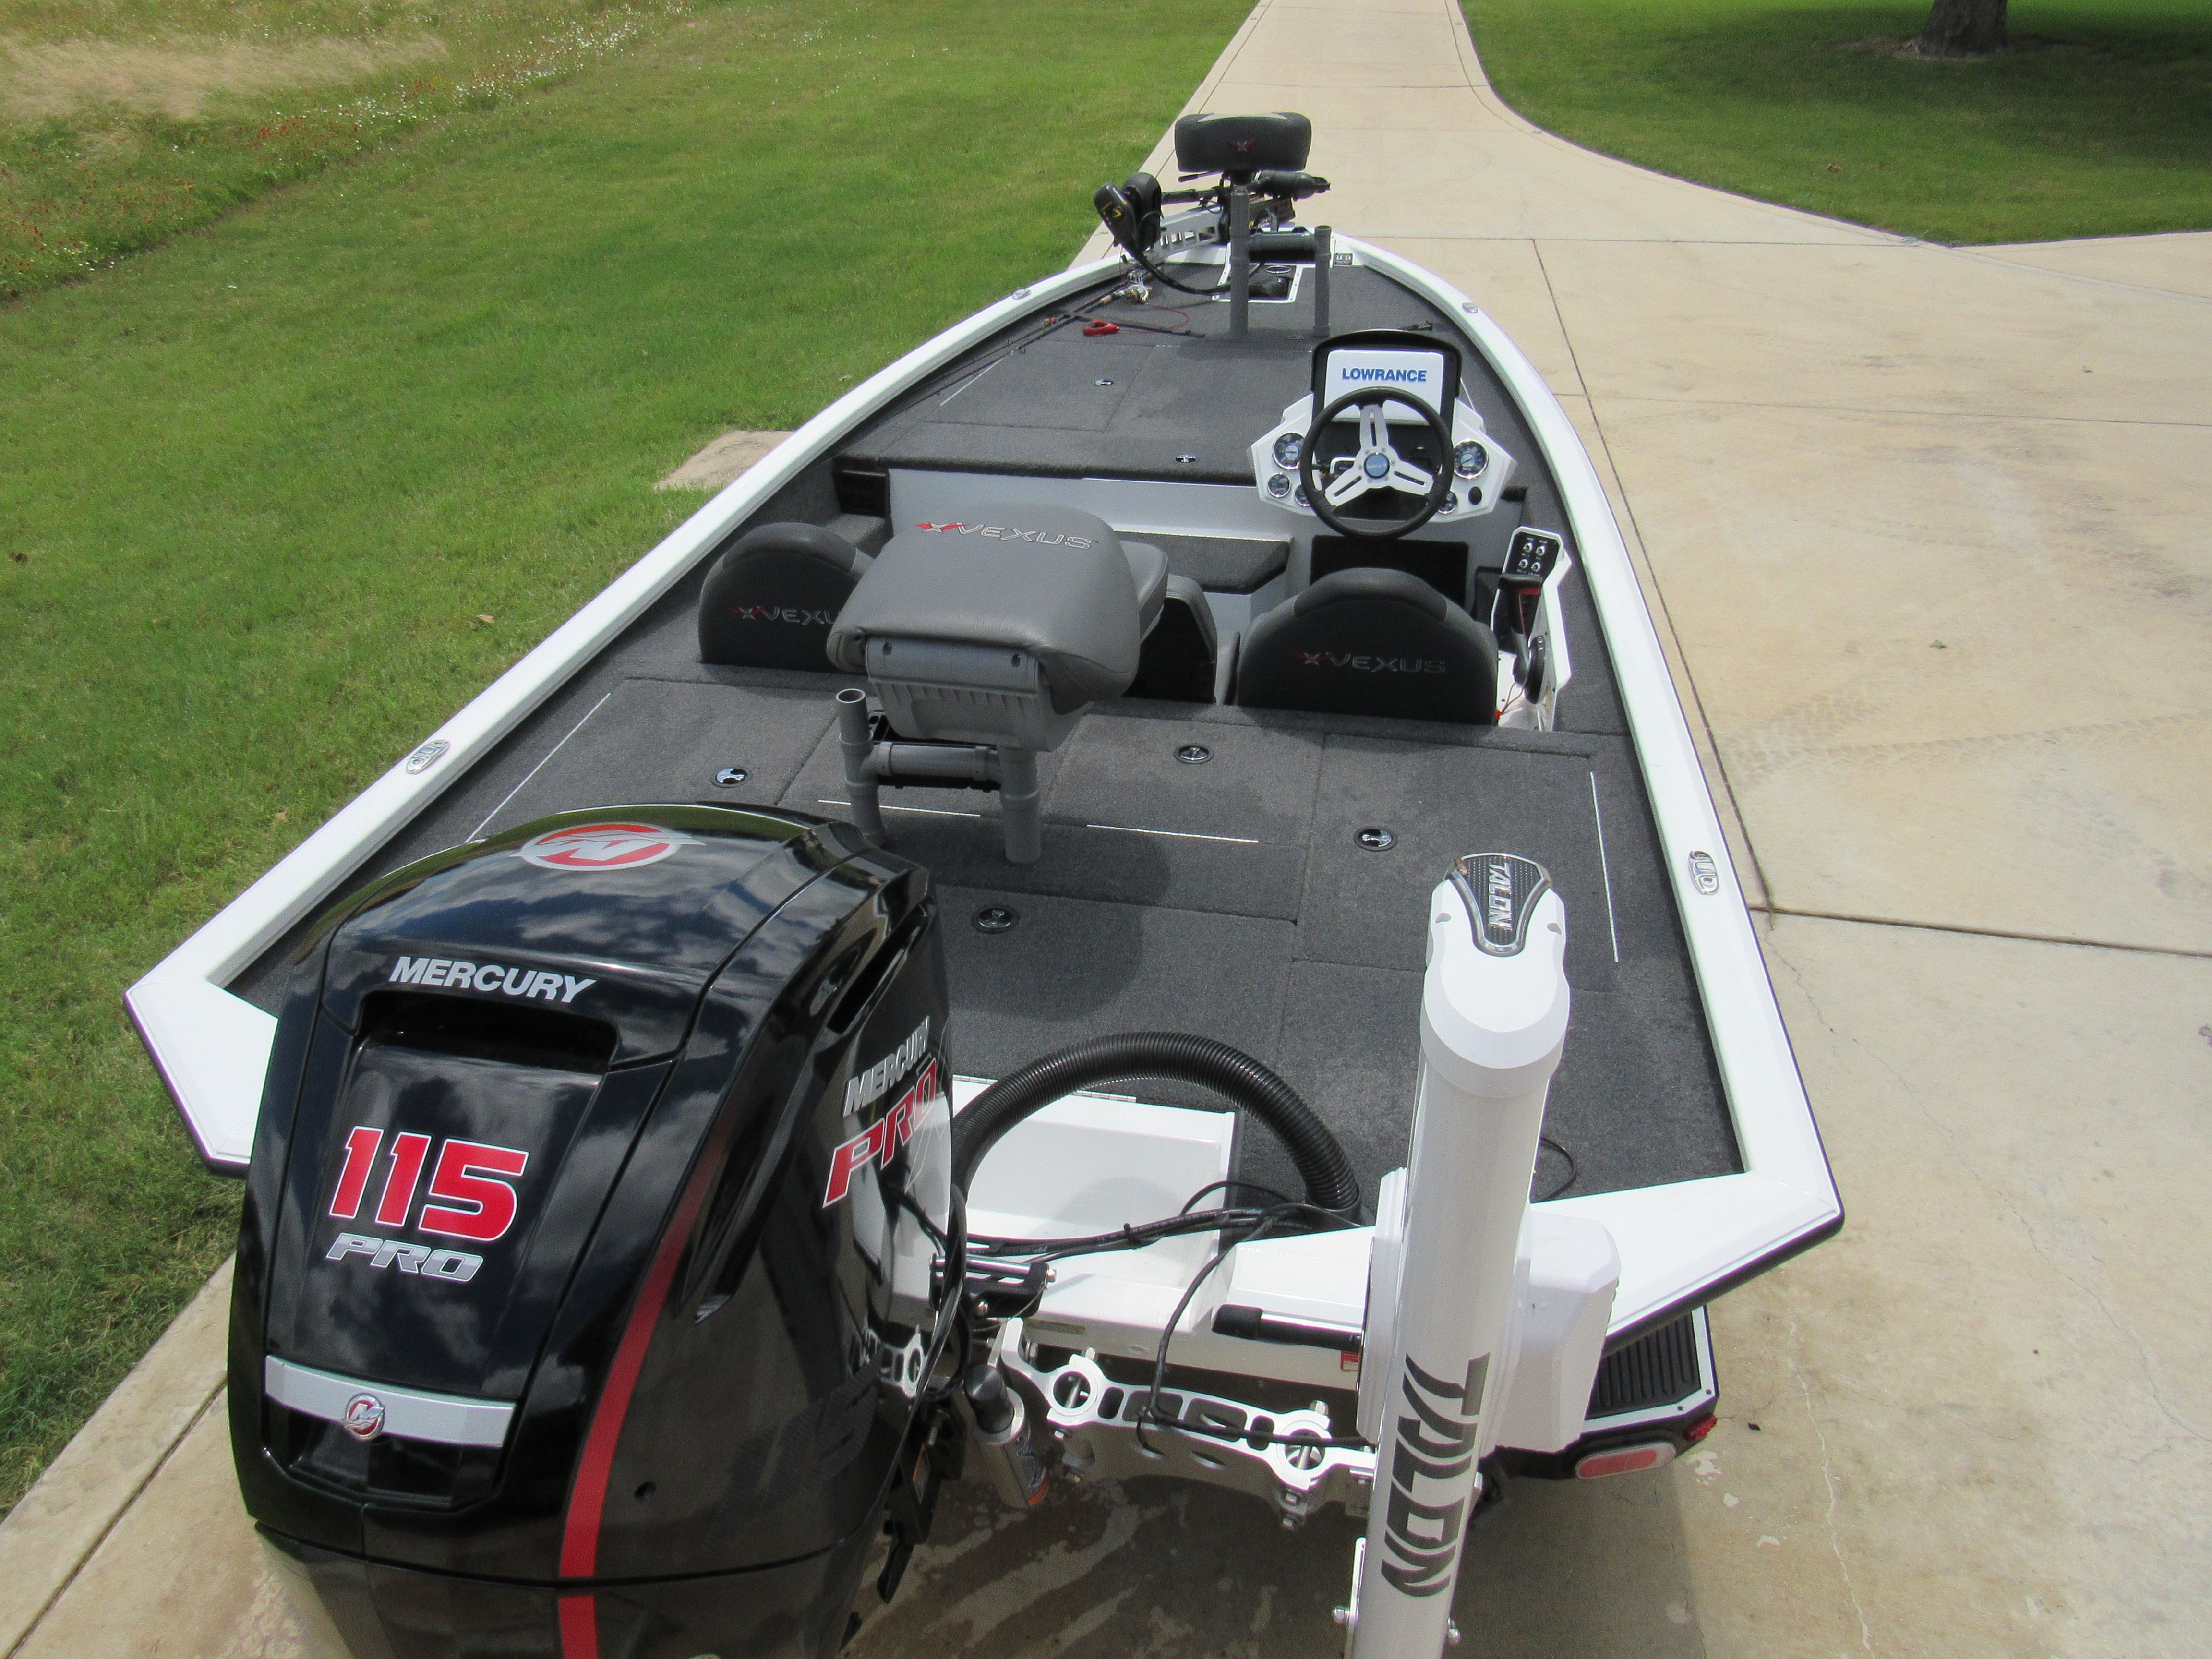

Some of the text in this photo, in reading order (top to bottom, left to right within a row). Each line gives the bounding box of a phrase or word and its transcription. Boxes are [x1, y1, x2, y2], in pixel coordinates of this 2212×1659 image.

[1342, 368, 1427, 382] LOWRANCE
[955, 523, 1092, 550] VEXUS
[761, 606, 835, 625] VEXU
[1326, 652, 1446, 673] VEXUS
[1488, 863, 1513, 930] TALON
[389, 957, 597, 1003] MERCURY
[823, 1057, 937, 1208] PRO
[329, 1126, 529, 1242] 115
[326, 1233, 483, 1281] PRO
[1381, 1352, 1490, 1597] TALON
